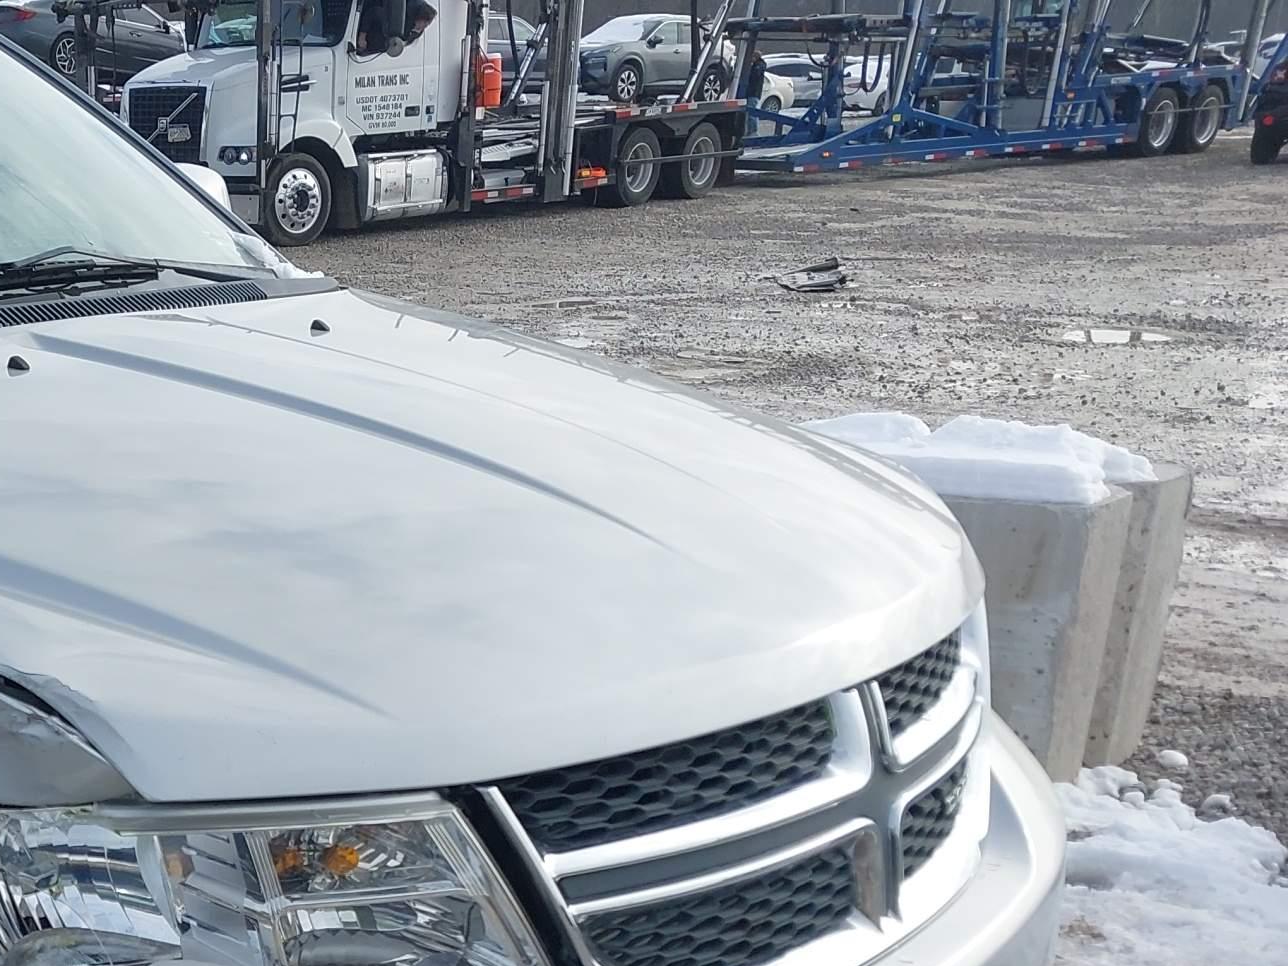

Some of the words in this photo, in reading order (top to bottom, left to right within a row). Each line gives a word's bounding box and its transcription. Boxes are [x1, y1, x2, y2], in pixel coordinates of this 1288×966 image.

[355, 76, 376, 88] MILAN
[377, 74, 398, 87] TRANS
[399, 73, 410, 85] INC
[355, 96, 378, 104] USDOT
[362, 113, 374, 121] VIN
